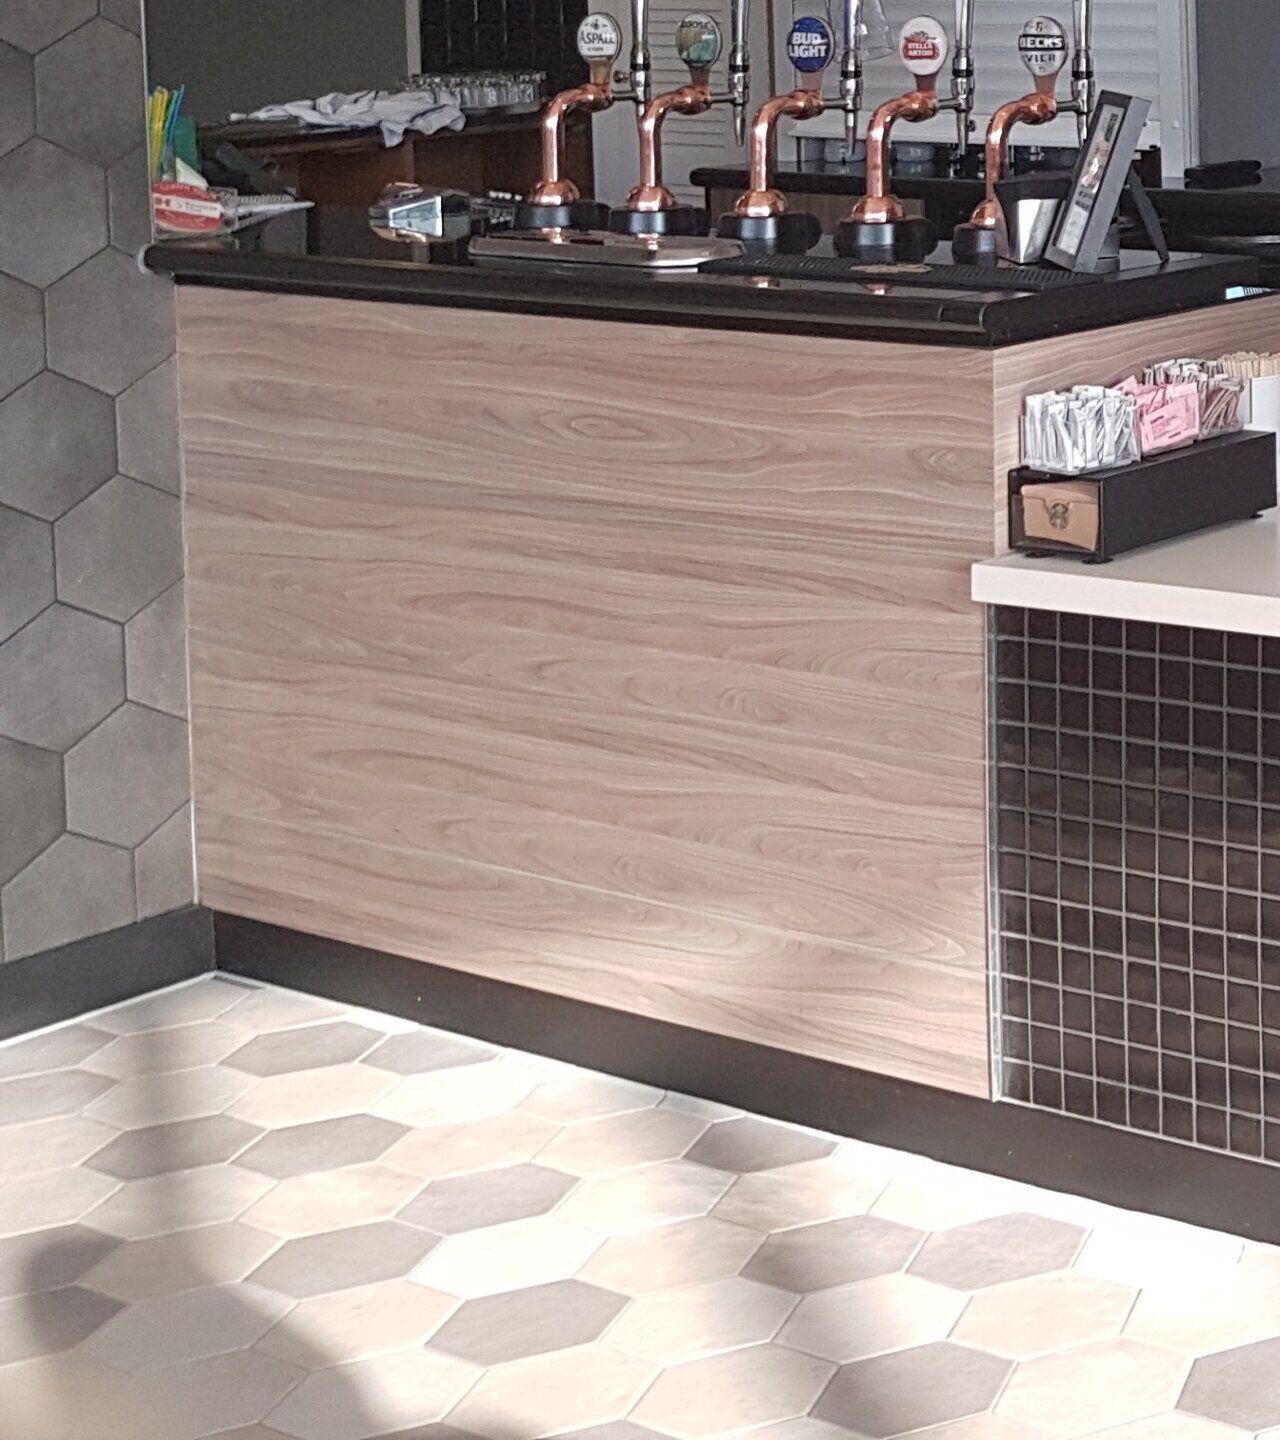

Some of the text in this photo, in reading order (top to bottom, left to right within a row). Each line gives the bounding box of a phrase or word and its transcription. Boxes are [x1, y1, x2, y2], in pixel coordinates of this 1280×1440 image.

[580, 30, 615, 44] ASPALL
[793, 31, 822, 44] BUD
[789, 44, 826, 58] LIGHT
[907, 42, 932, 50] STELLA
[1024, 54, 1056, 62] VIER
